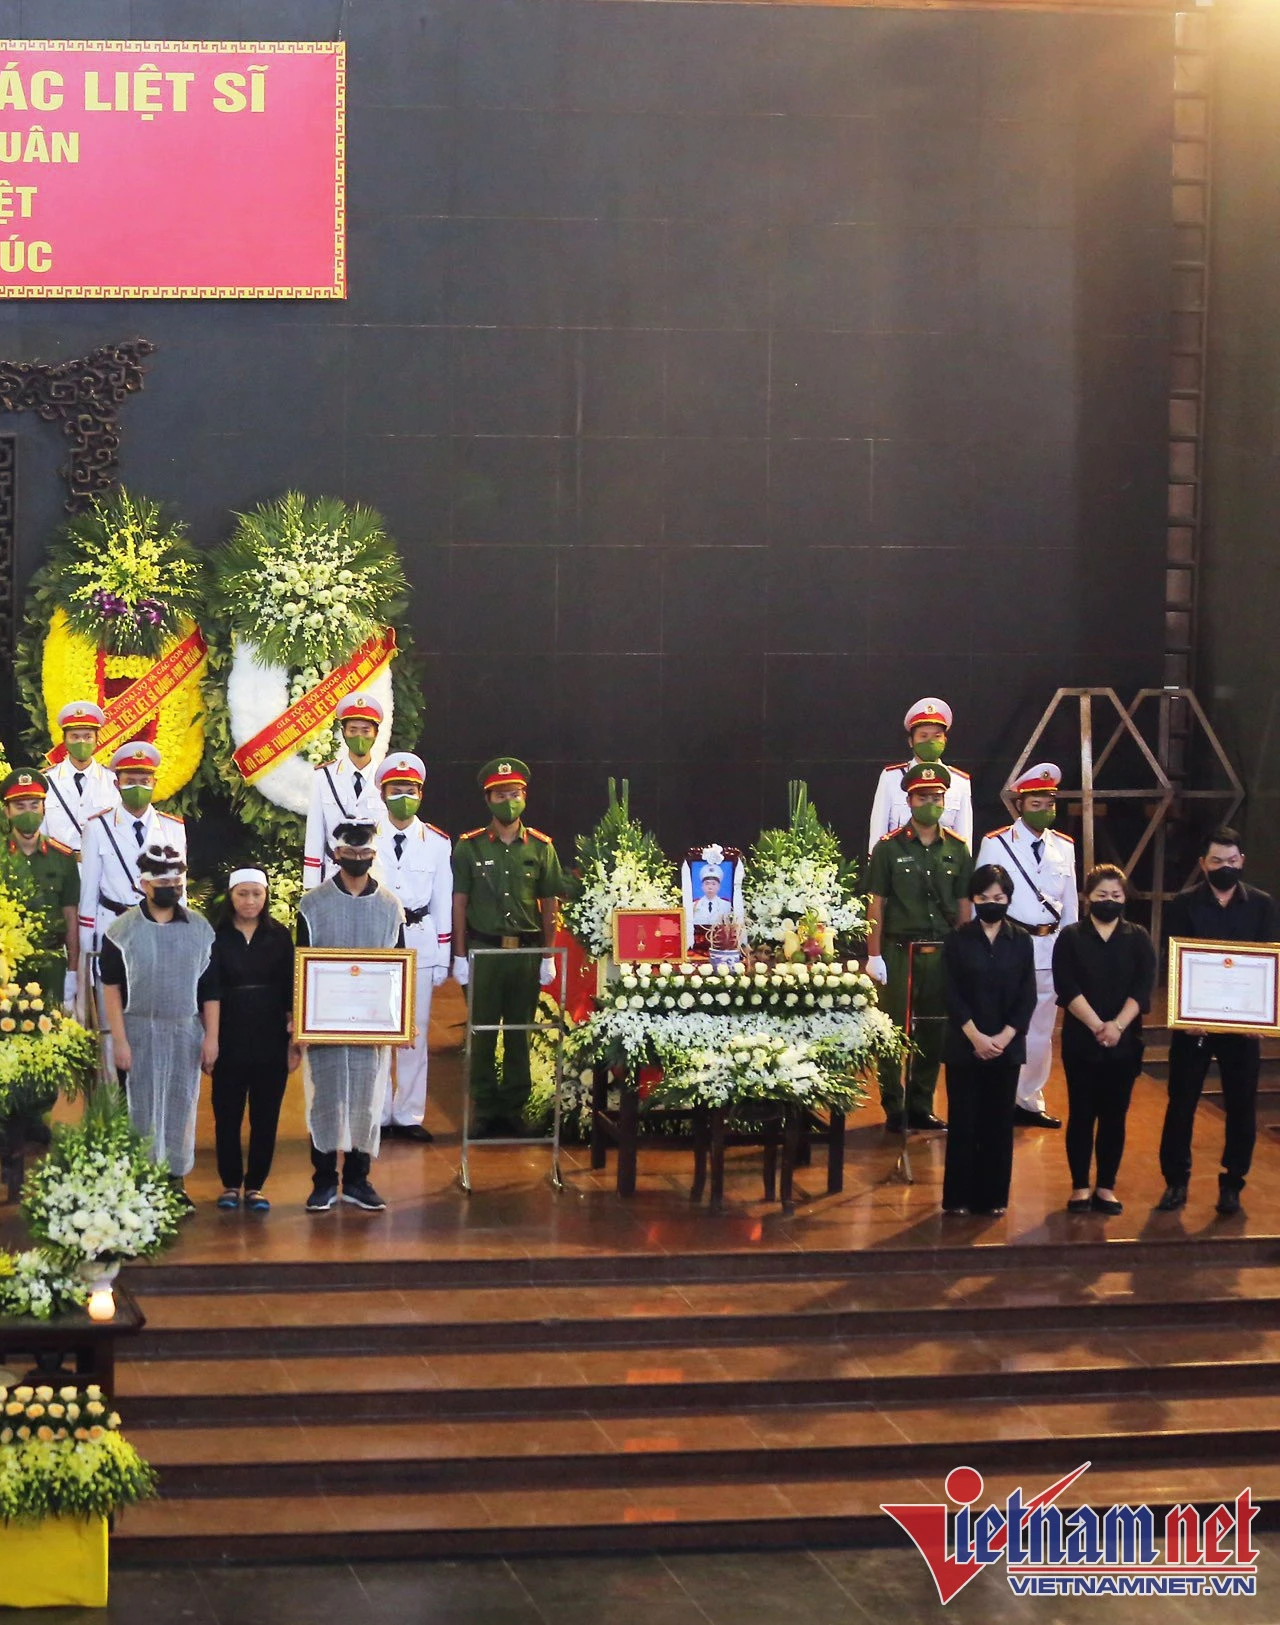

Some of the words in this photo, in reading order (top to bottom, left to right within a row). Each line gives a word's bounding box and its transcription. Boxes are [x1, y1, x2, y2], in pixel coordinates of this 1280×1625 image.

[85, 64, 195, 120] LIỆT
[213, 65, 269, 113] SĨ
[276, 717, 291, 729] GIA
